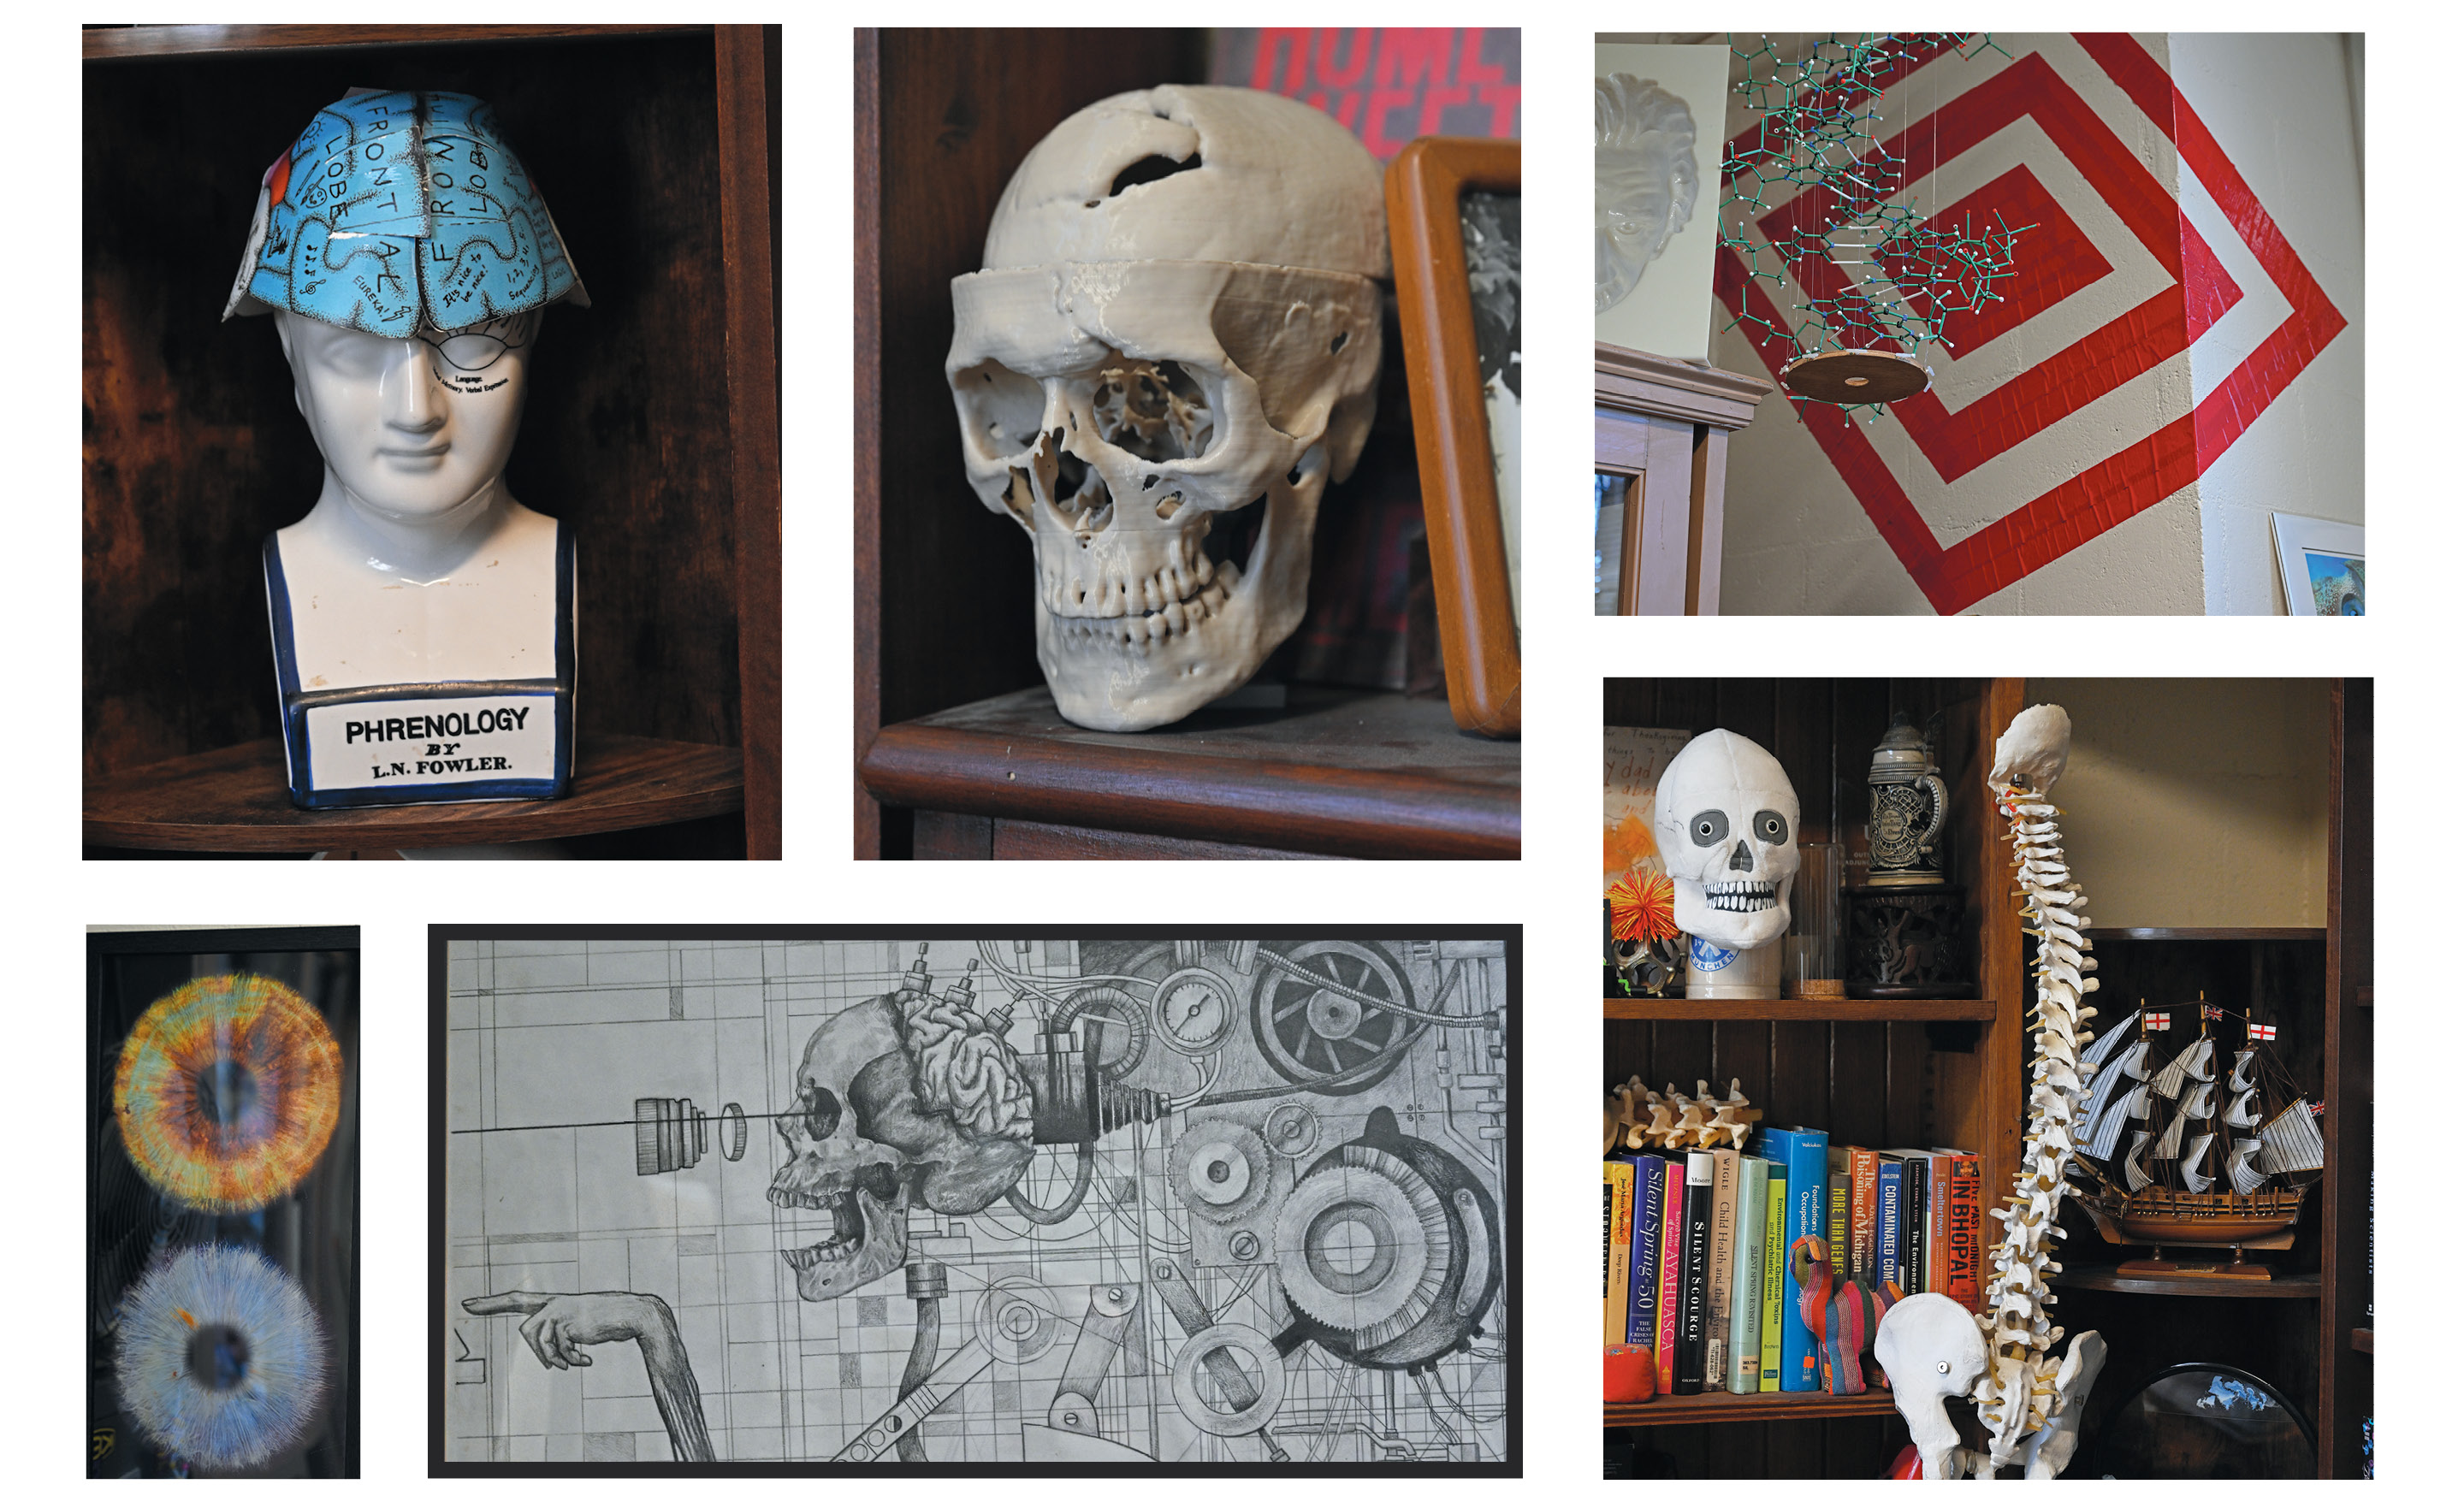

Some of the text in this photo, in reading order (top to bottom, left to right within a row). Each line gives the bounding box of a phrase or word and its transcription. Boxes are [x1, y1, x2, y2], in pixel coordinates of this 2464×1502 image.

[325, 135, 348, 220] LOBE
[457, 266, 472, 287] nice
[471, 253, 482, 263] to
[460, 263, 489, 303] be nice!
[352, 275, 390, 318] EUREKA!
[346, 707, 530, 744] PHRENOLOGY
[371, 756, 512, 779] L.N. FOWLER.
[424, 742, 461, 757] BY
[1620, 755, 1655, 778] dad
[1690, 951, 1735, 970] MÜNCHEN
[1646, 1168, 1663, 1218] Silent
[1721, 1157, 1730, 1191] WIGLE
[1864, 1168, 1876, 1189] The
[1952, 1180, 1970, 1199] IN
[1718, 1201, 1730, 1228] Child
[1775, 1197, 1784, 1251] Environmental
[1811, 1185, 1821, 1232] Foundations
[1851, 1153, 1871, 1273] Poisoning of Michigan
[1936, 1181, 1946, 1237] Smeltertown
[1637, 1219, 1660, 1279] Spring
[1716, 1232, 1728, 1264] Health
[1830, 1188, 1846, 1274] MORE THAN GENES
[1883, 1186, 1897, 1282] CONTAMINATED COM
[1950, 1203, 1970, 1286] BHOPAL
[1969, 1180, 1981, 1283] FIVE PAST MIDNIGHT
[1767, 1236, 1775, 1275] Psychiatric
[1688, 1221, 1705, 1341] SILENT SCOURGE
[1715, 1267, 1725, 1284] and
[1638, 1285, 1655, 1309] 50
[1661, 1249, 1678, 1351] AYAHUASCA
[1715, 1288, 1725, 1303] the
